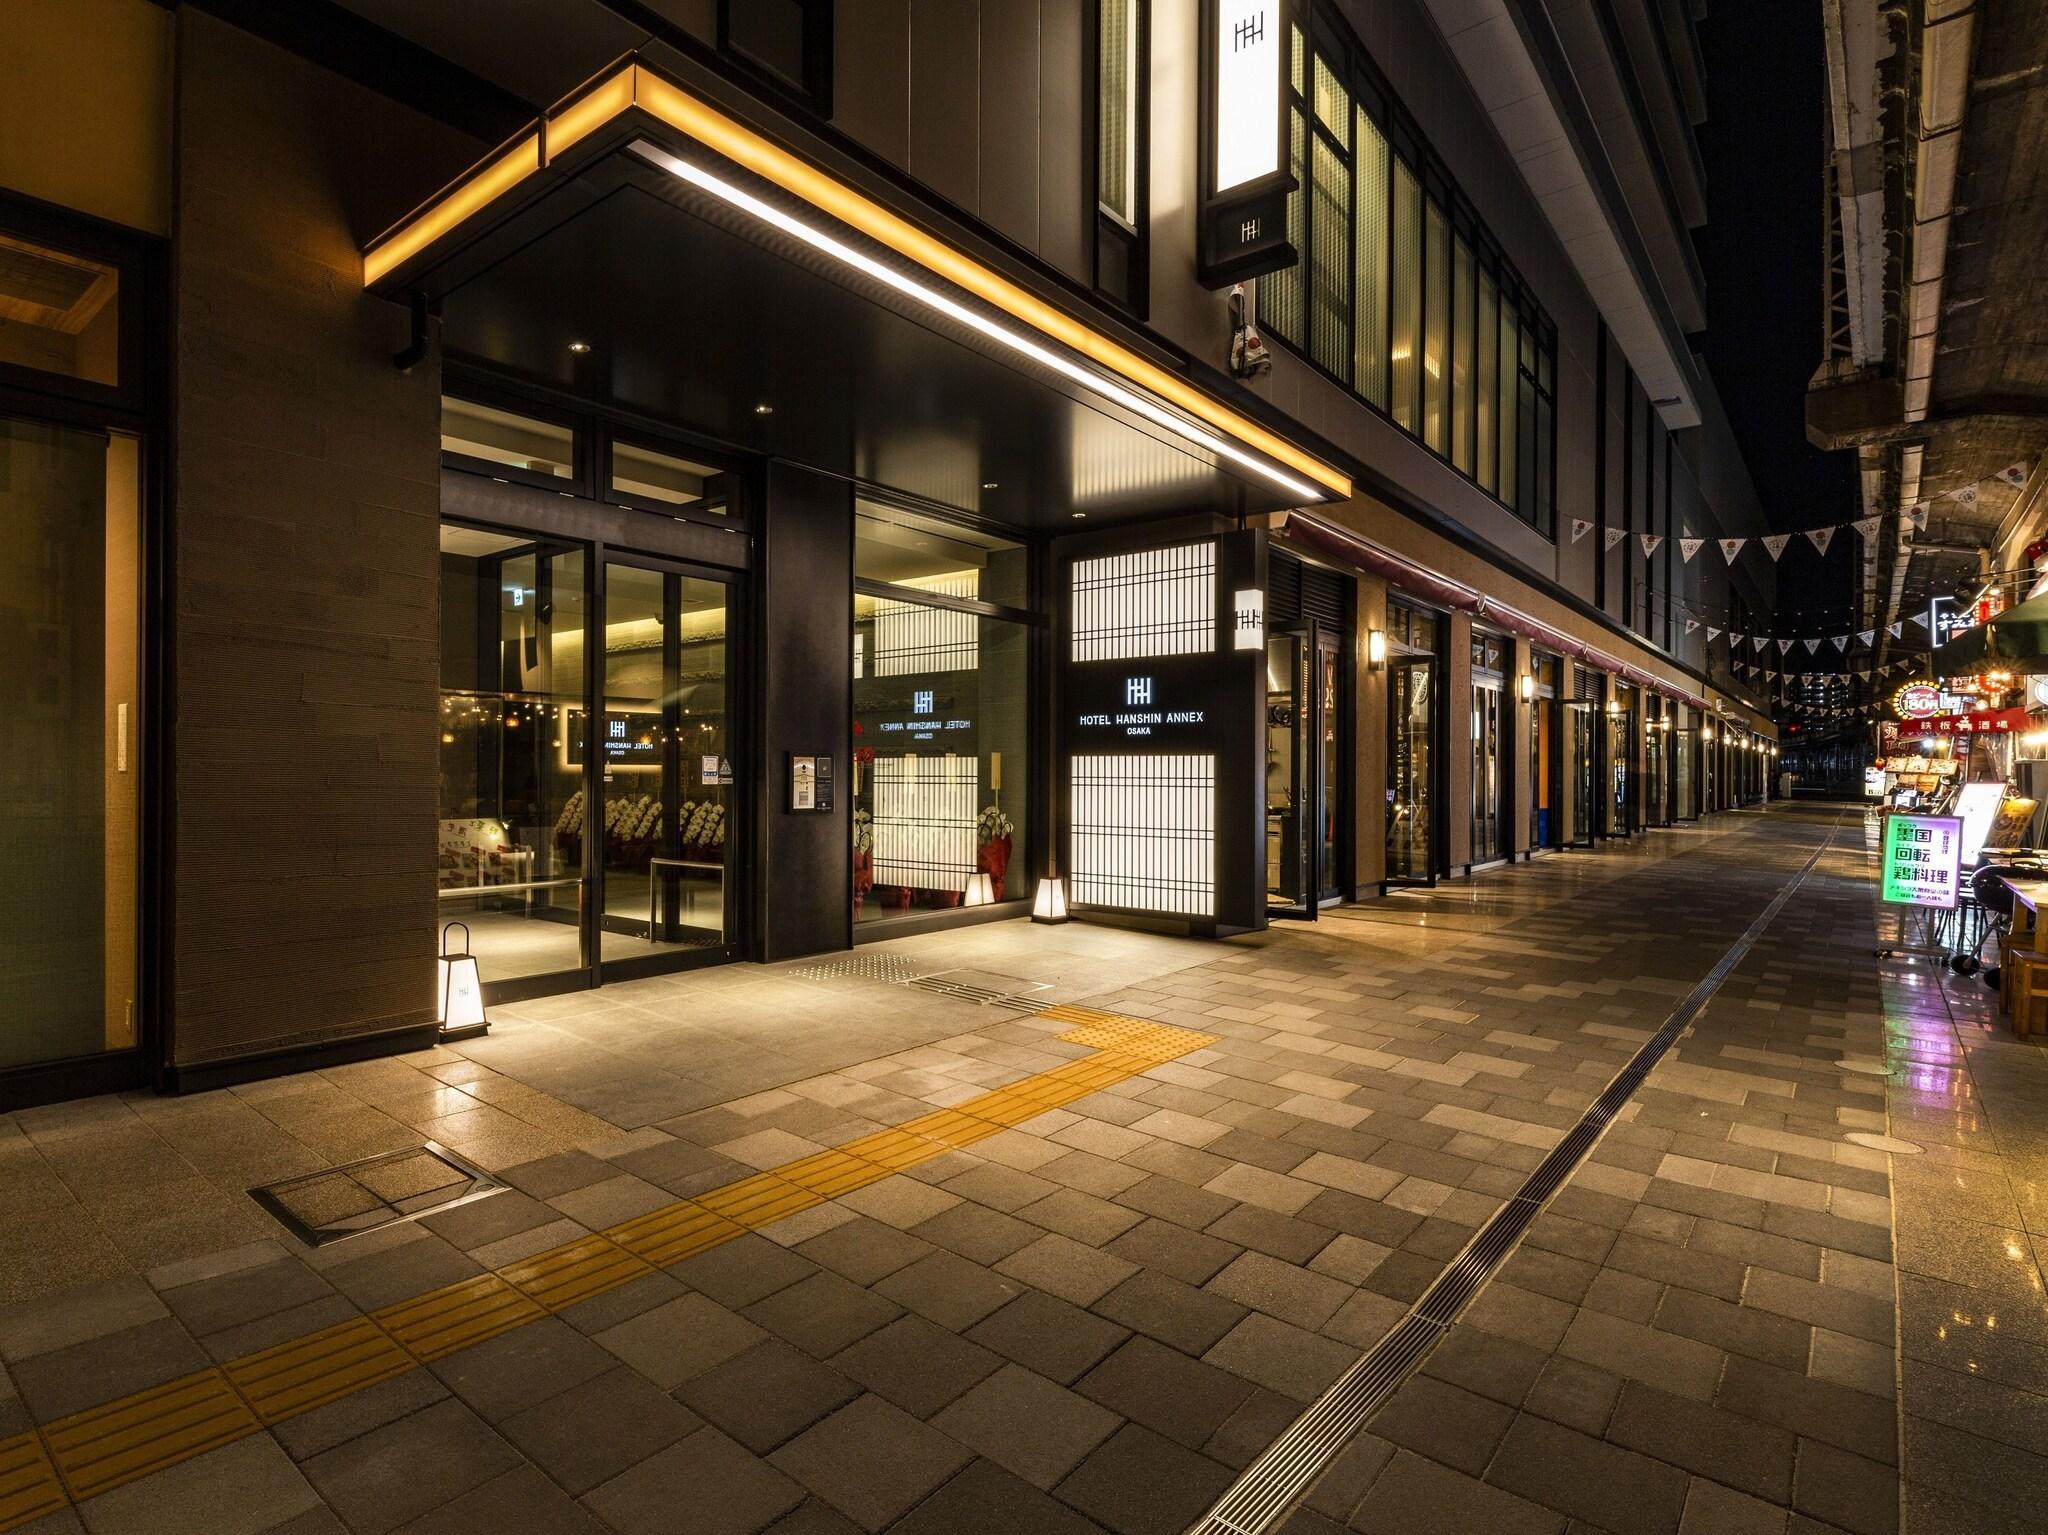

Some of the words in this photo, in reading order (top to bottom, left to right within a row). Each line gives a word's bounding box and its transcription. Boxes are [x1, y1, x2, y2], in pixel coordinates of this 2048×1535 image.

[1080, 715, 1111, 726] HOTEL
[1116, 713, 1161, 724] HANSHIN
[1166, 712, 1204, 723] ANNEX
[1127, 727, 1151, 735] OSAKA
[1895, 847, 1931, 862] 回転
[1893, 867, 1948, 884] 鶏料理
